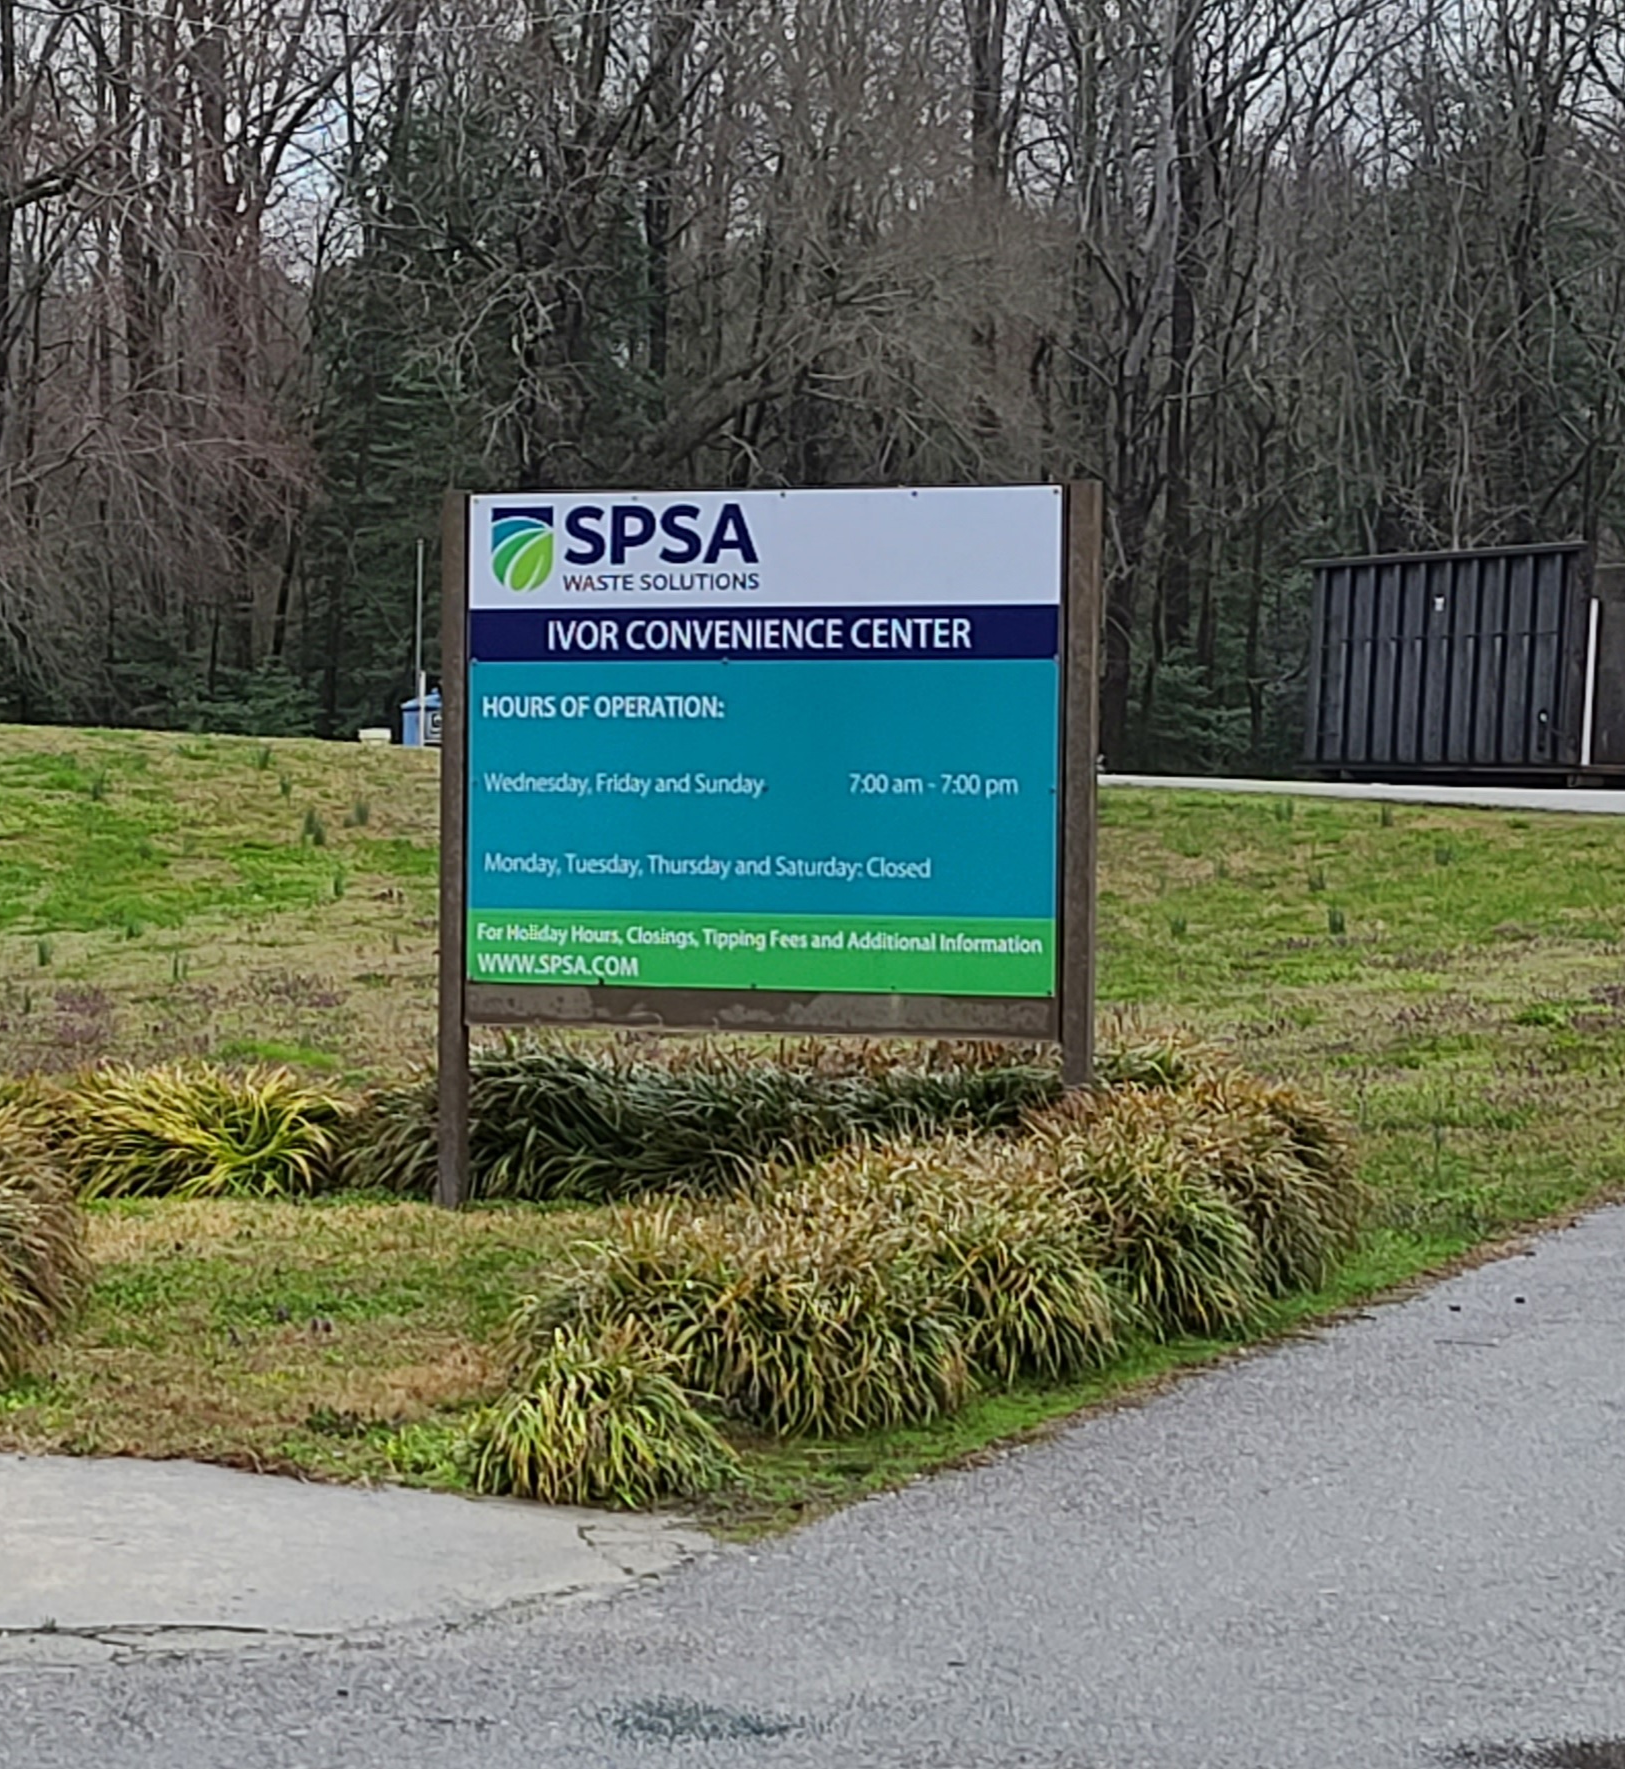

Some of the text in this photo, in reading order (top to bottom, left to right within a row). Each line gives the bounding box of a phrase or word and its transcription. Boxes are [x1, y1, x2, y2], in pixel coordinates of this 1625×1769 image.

[564, 503, 760, 565] SPSA
[562, 573, 761, 592] WASTE SOLUTIONS
[547, 618, 973, 650] IVOR CONVENIENCE CENTER
[481, 695, 726, 718] HOURS OF OPERATION:
[483, 771, 593, 798] Wednesday,
[595, 772, 651, 798] Friday
[654, 773, 691, 793] and
[848, 772, 889, 794] 7:00
[891, 777, 924, 794] am
[939, 773, 982, 795] 7:00
[984, 776, 1020, 799] pm
[483, 852, 933, 882] Monday, Tuesday, Thursday and Saturday: Closed
[476, 922, 1043, 954] For Holiday Hours, Closings, Tipping Fees and Additional Information
[476, 952, 639, 977] WWW.SPSA.COM
